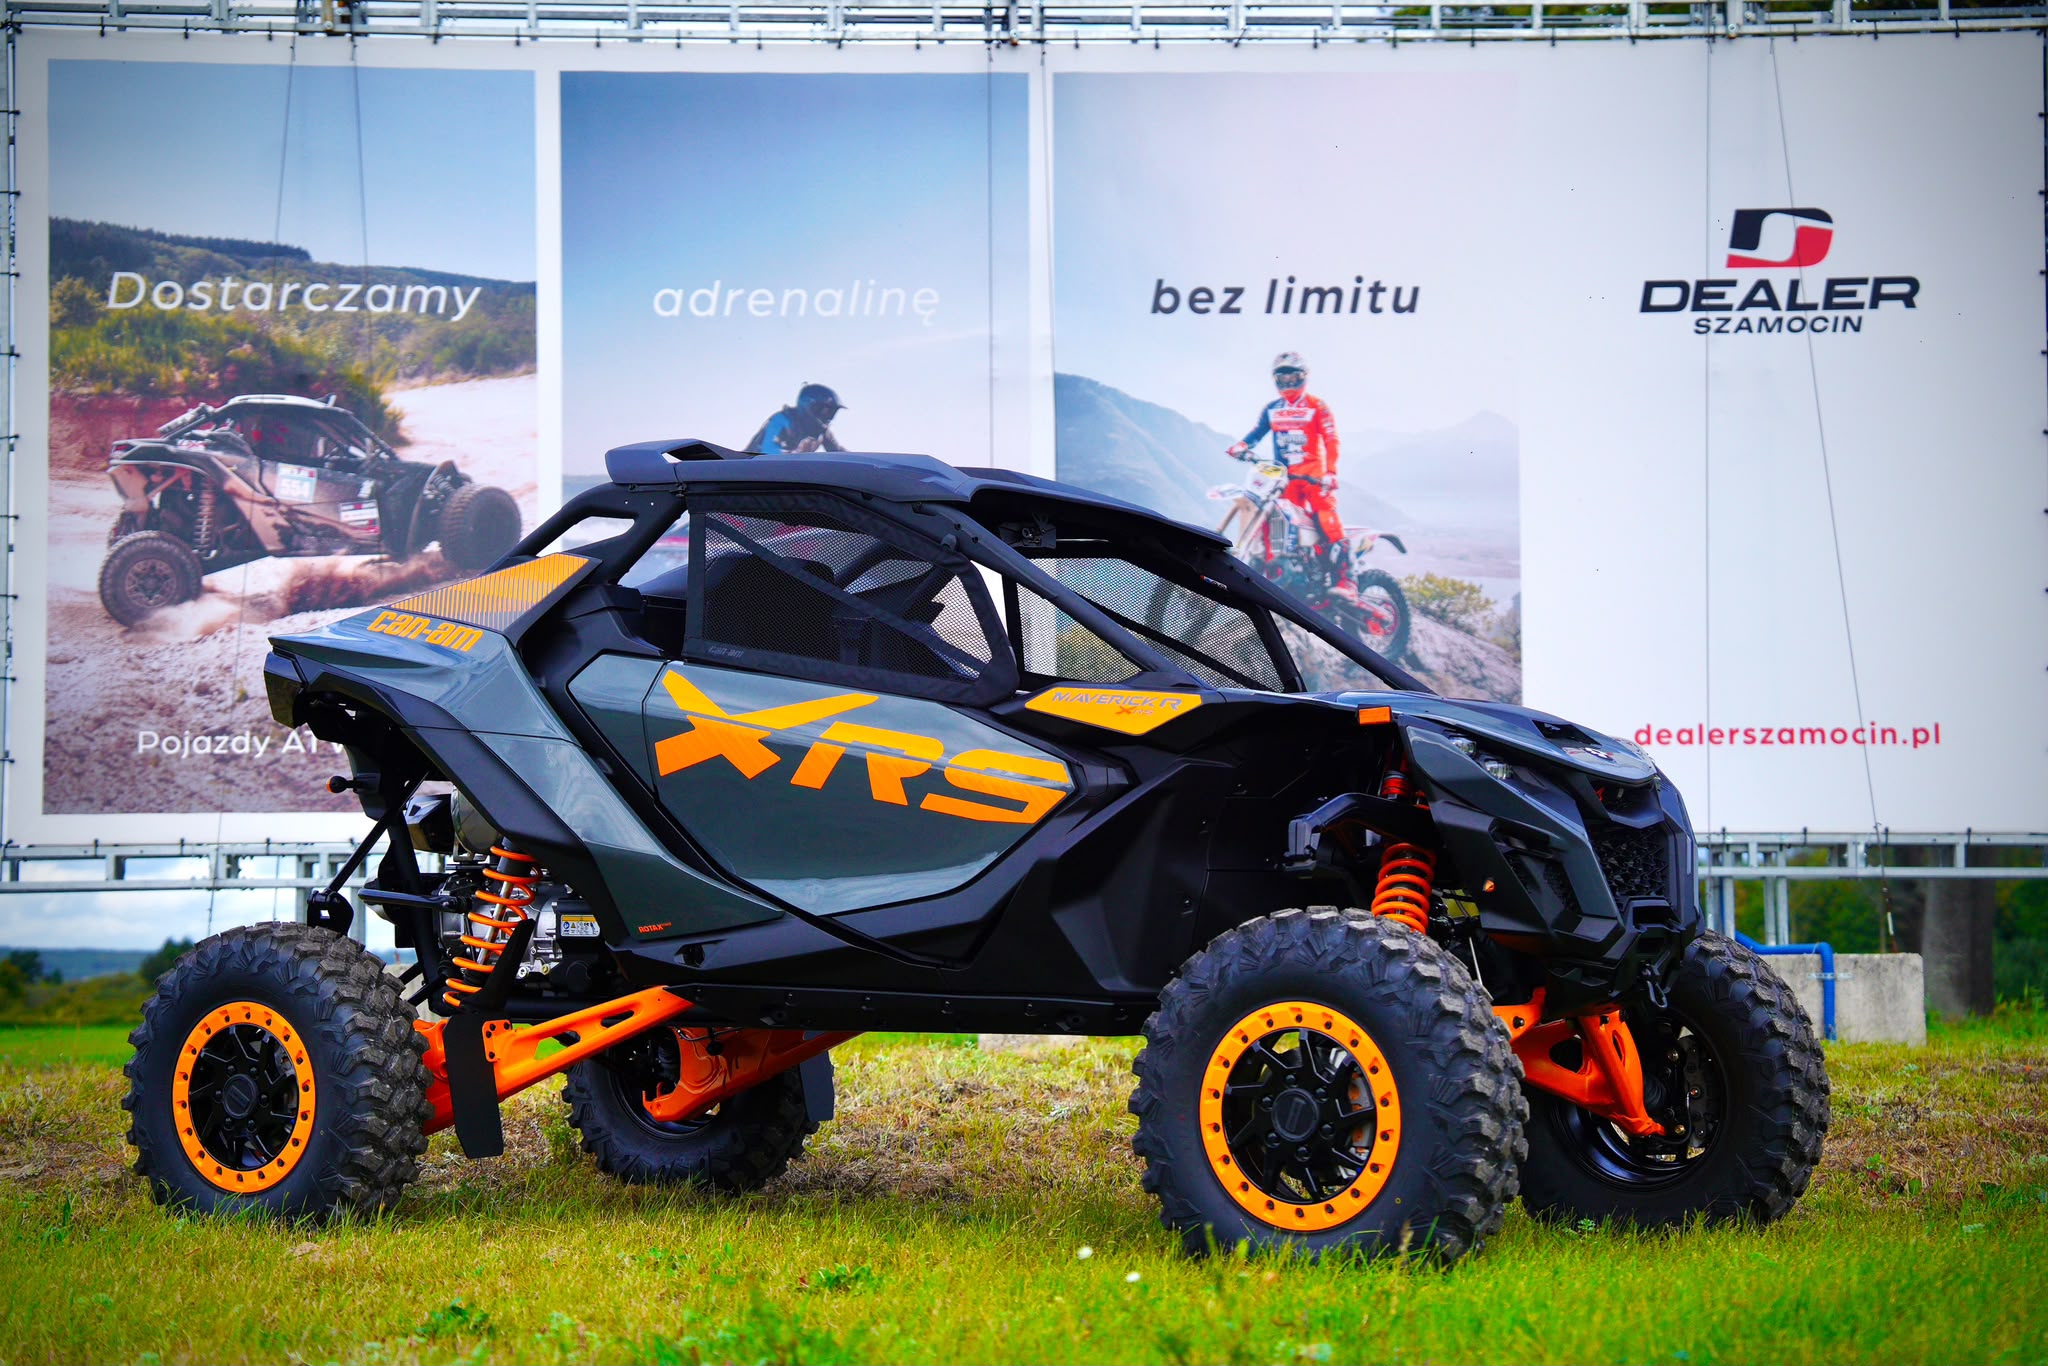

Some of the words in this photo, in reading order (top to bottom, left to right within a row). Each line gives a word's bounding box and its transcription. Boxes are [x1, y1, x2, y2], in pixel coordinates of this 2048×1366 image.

[107, 271, 483, 321] Dostarczamy
[653, 279, 941, 326] adrenalinę
[1151, 278, 1245, 315] bez
[1265, 275, 1421, 315] limitu
[1639, 275, 1921, 313] DEALER
[1694, 315, 1863, 334] SZAMOCIN
[367, 610, 484, 652] can-am
[1052, 691, 1158, 706] MAVERICK
[1159, 697, 1182, 711] R
[137, 730, 271, 758] Pojazdy
[654, 668, 1070, 824] XRS
[1635, 722, 1941, 749] dealerszamocin.pl
